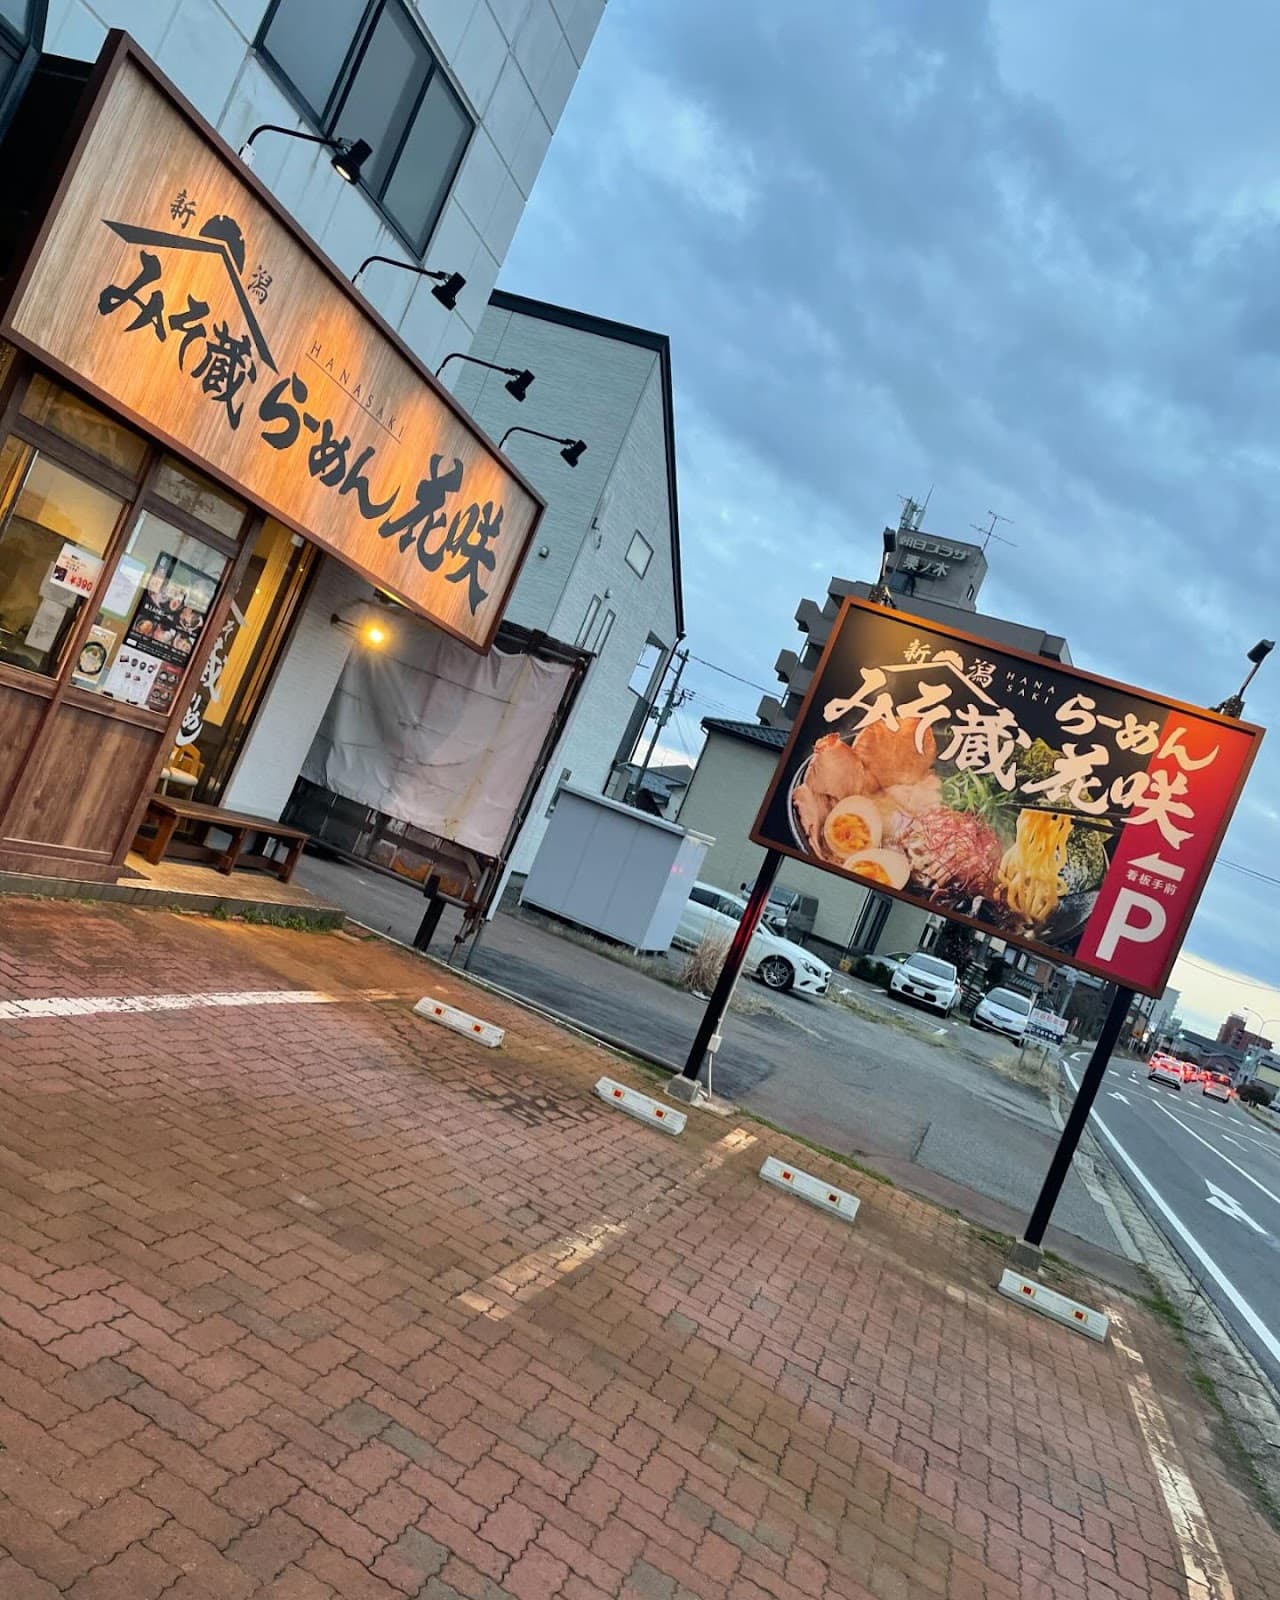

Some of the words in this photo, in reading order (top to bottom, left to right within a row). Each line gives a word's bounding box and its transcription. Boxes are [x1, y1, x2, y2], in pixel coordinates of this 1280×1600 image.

[310, 340, 405, 439] HANASAKI
[98, 250, 257, 430] みそ蔵
[258, 371, 401, 519] らーめん
[378, 453, 504, 616] 花咲
[1006, 671, 1056, 695] HANA
[1006, 684, 1050, 705] SAKI
[823, 667, 1032, 791] みそ蔵
[1055, 693, 1220, 771] らーめん
[1020, 743, 1195, 850] 花咲
[1125, 869, 1178, 896] 看板手前
[1095, 887, 1167, 962] P
